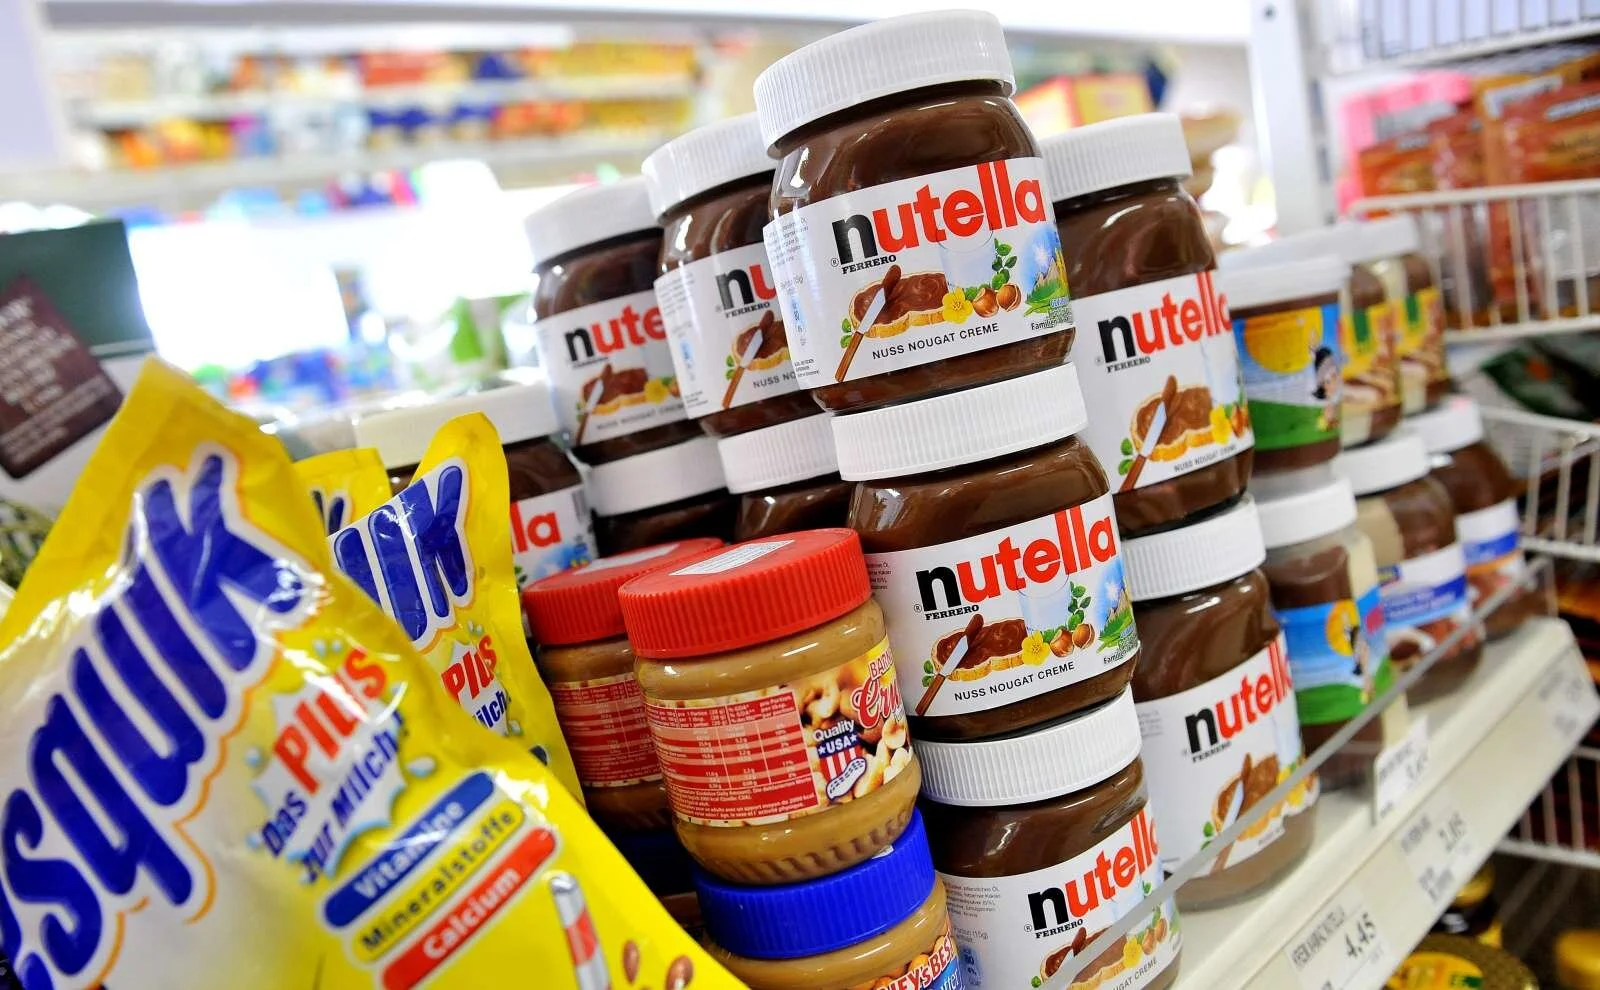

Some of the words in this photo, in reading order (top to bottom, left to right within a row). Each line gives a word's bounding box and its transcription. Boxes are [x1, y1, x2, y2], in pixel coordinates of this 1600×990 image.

[831, 160, 1047, 265] nutella
[841, 254, 897, 275] FERRERO
[724, 302, 771, 319] FERRERO
[565, 304, 667, 361] nute
[872, 344, 905, 360] NUSS
[908, 332, 956, 351] NOUGAT
[959, 322, 1000, 340] CREME
[752, 374, 781, 390] NUSS
[1106, 356, 1151, 374] FERRERO
[915, 505, 1117, 612] nutella
[925, 604, 980, 621] FERRERO
[954, 687, 986, 702] NUSS
[989, 674, 1034, 694] NOUGAT
[1037, 661, 1075, 679] CREME
[813, 719, 855, 742] Quality
[826, 737, 852, 753] USA
[261, 790, 308, 858] Das
[353, 800, 466, 900] Vitamine
[361, 808, 515, 951] Mineralstoffe
[422, 866, 523, 961] Calcium
[1035, 918, 1084, 939] FERRERO
[1345, 912, 1374, 958] 4.45
